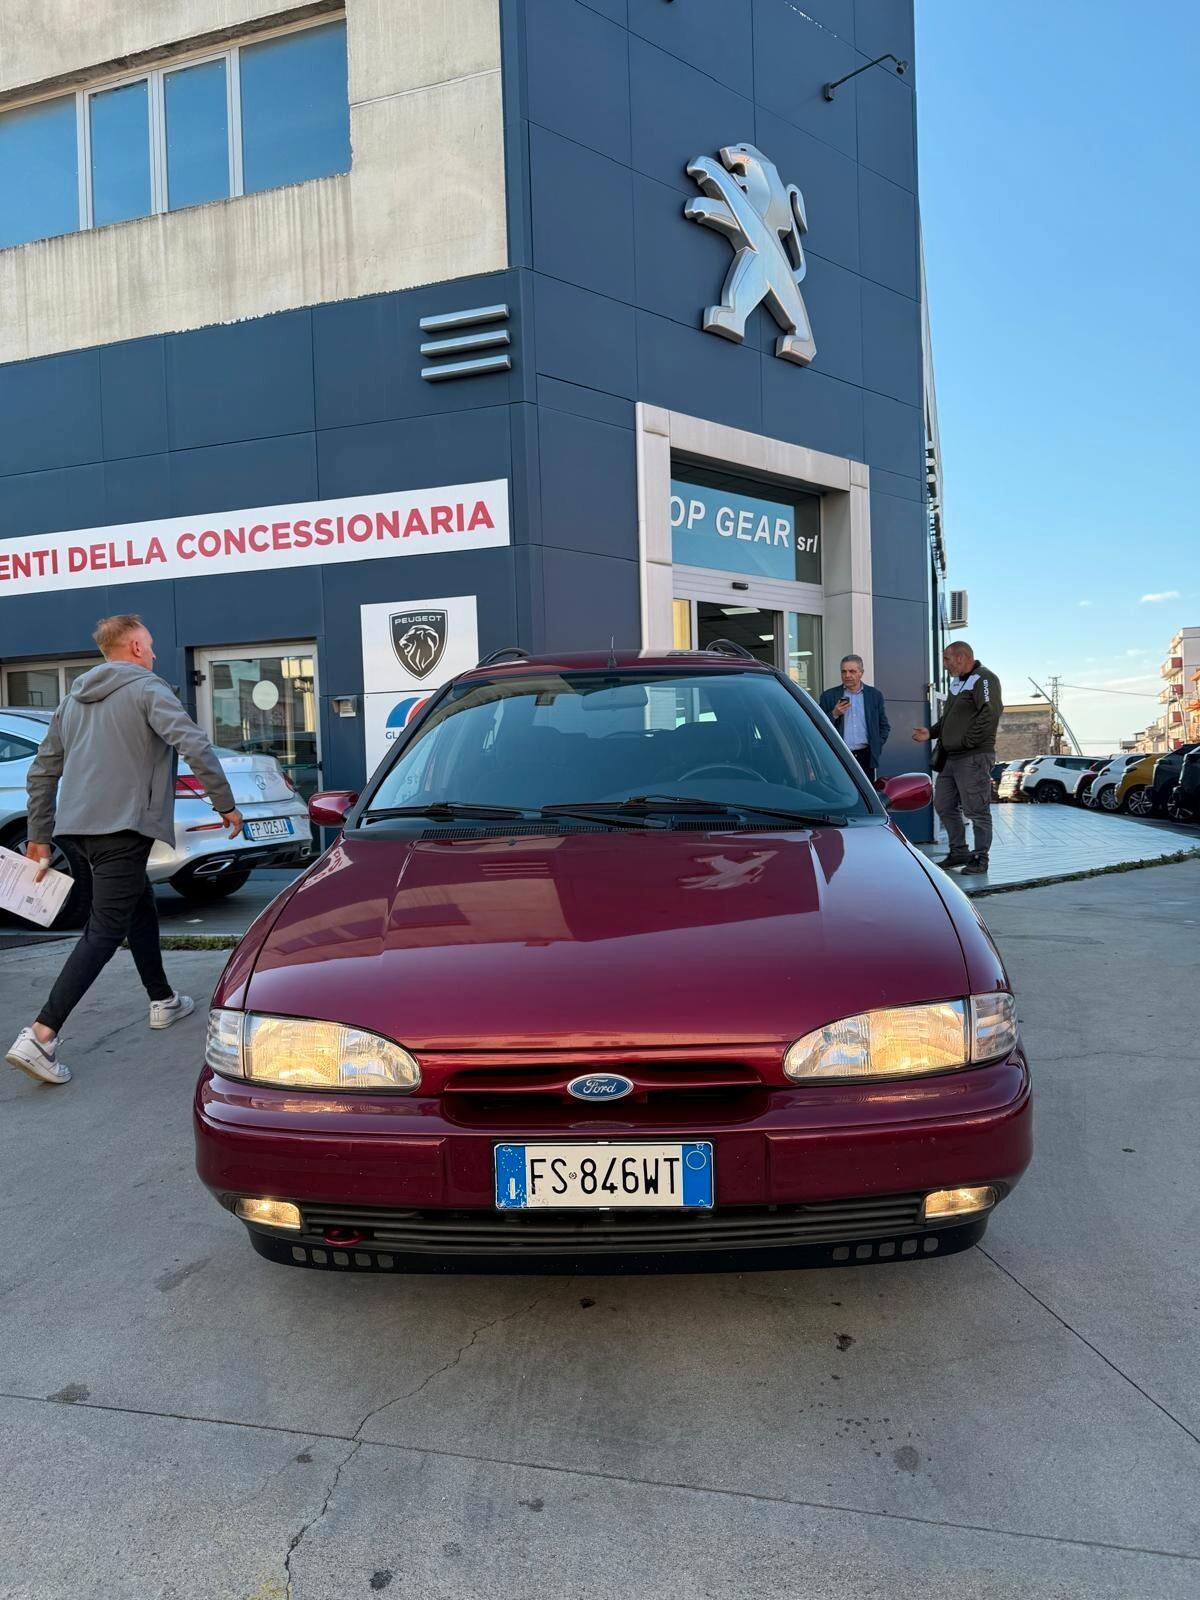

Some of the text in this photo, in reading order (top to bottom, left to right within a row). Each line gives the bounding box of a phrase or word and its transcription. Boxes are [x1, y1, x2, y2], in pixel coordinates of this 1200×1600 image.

[0, 501, 495, 580] ENTI DELLA CONCESSIONARIA
[715, 506, 791, 548] GEAR
[797, 535, 818, 553] srl
[394, 615, 442, 625] PEUGEOT
[583, 1079, 617, 1094] Ford
